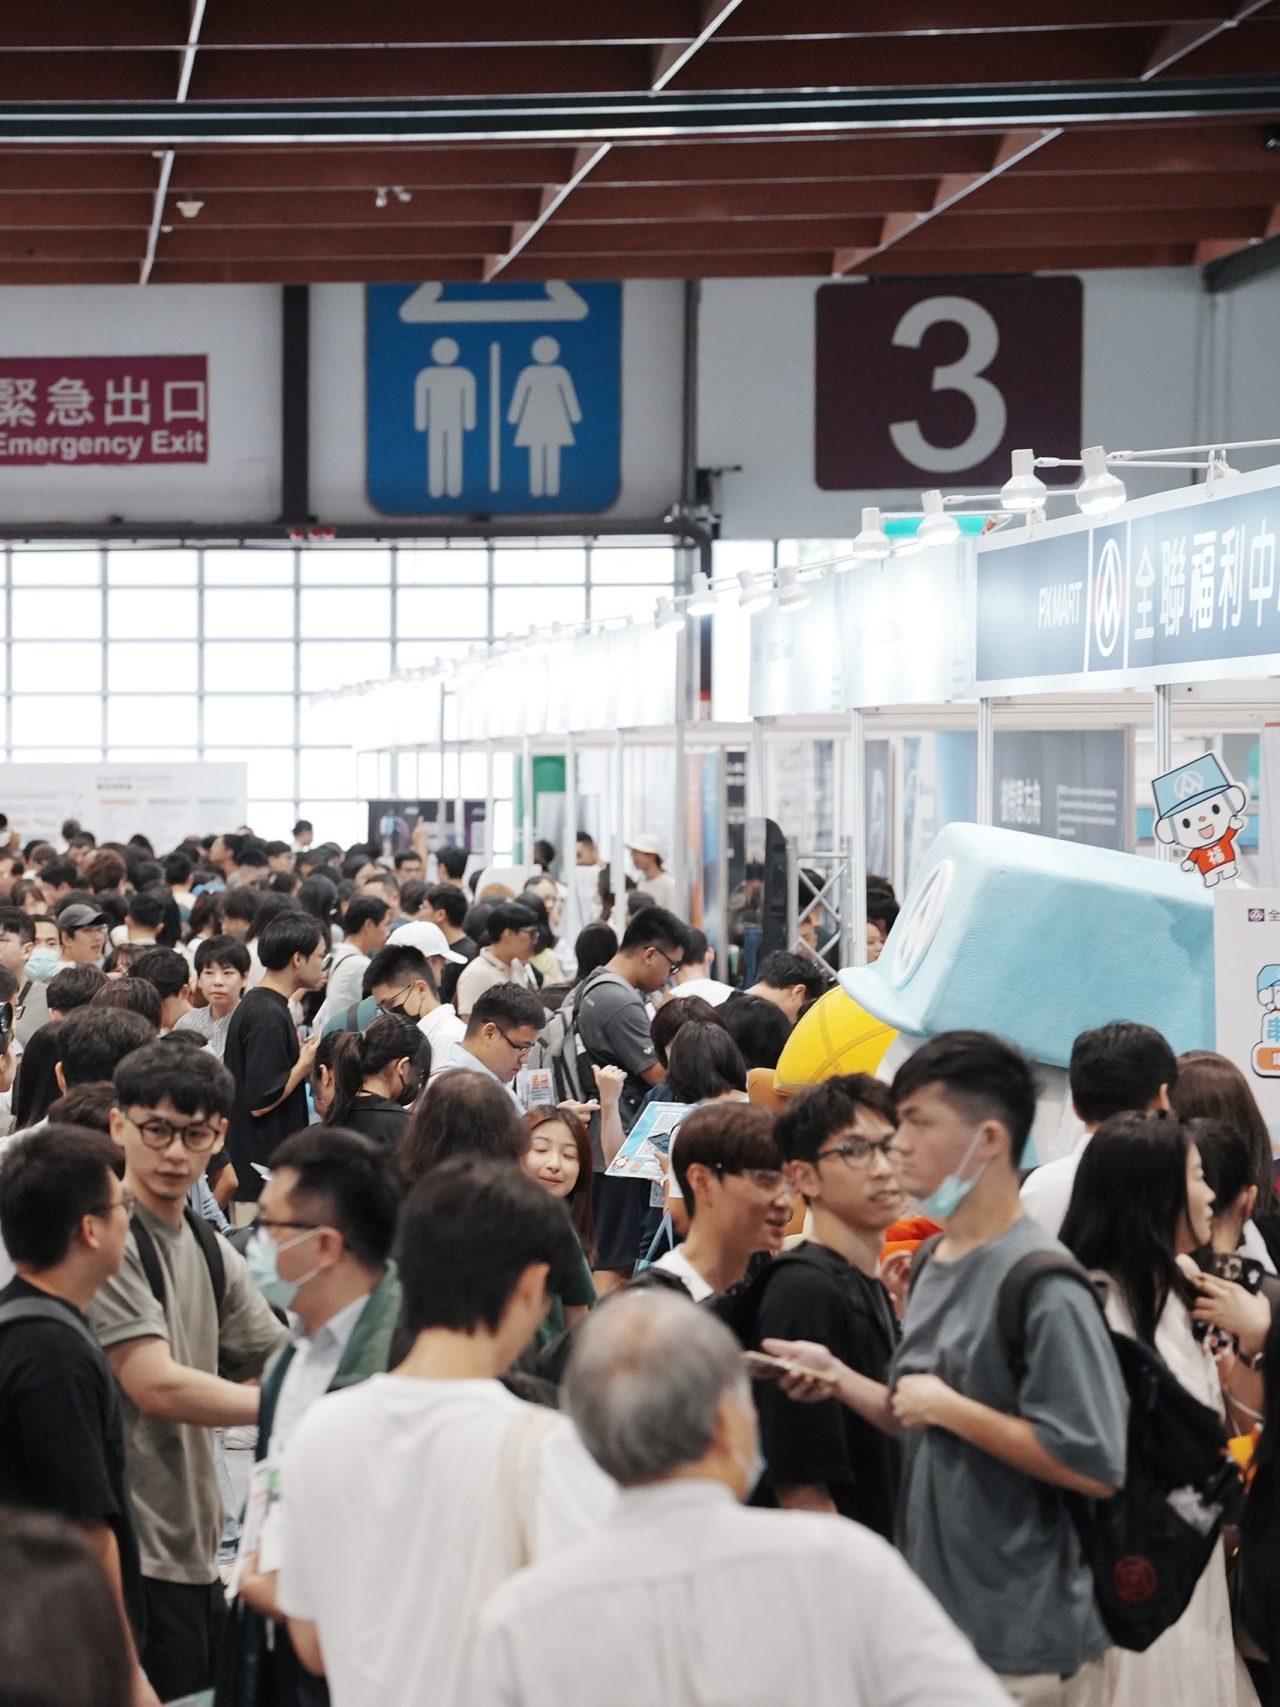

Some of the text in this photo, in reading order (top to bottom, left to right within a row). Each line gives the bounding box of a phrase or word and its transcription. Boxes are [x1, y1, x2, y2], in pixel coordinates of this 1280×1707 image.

[888, 295, 1008, 473] 3
[151, 430, 205, 456] Exit
[1134, 518, 1280, 640] 全聯福利中
[1208, 846, 1225, 865] 福
